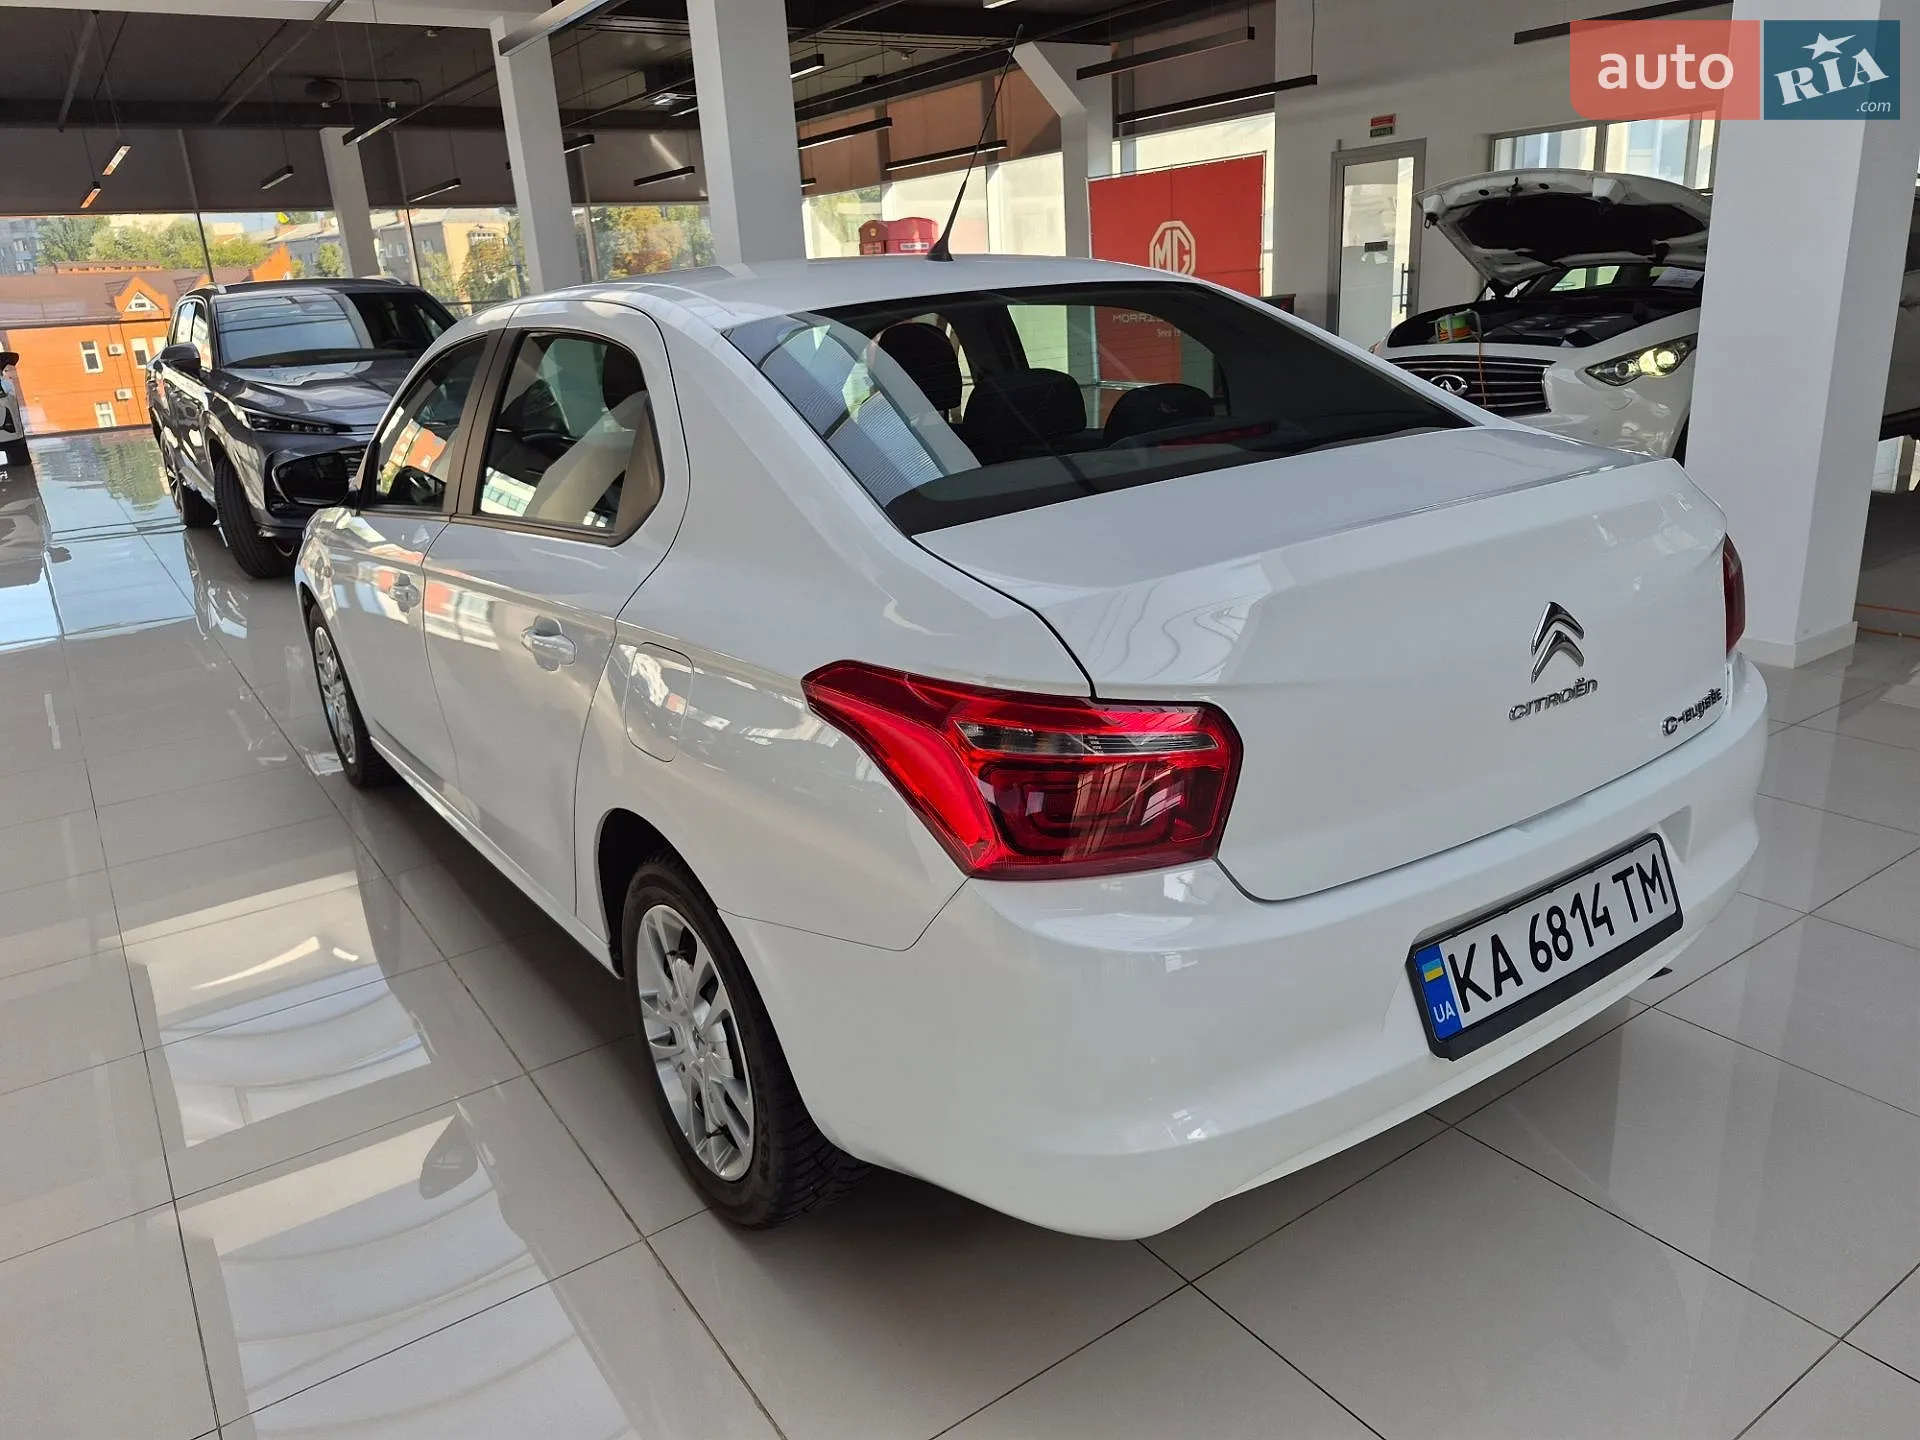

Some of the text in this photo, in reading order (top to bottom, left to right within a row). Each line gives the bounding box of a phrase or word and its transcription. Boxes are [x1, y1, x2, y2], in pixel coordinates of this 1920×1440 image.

[1154, 227, 1191, 275] MG
[1447, 853, 1669, 1014] KA 6814 TM
[1433, 1000, 1457, 1024] UA
